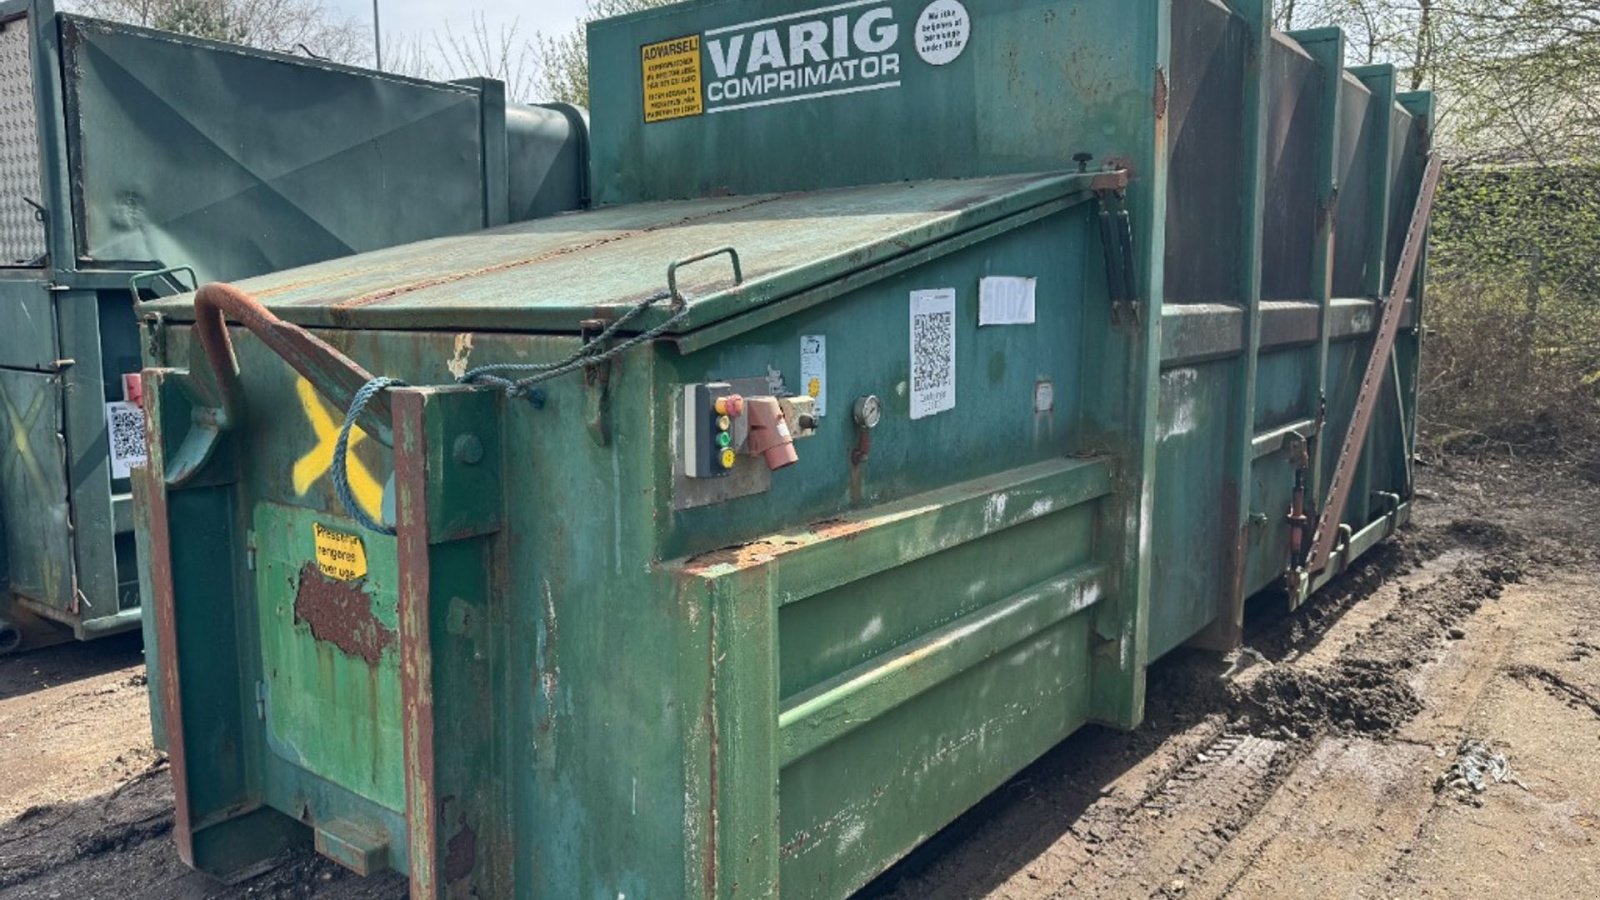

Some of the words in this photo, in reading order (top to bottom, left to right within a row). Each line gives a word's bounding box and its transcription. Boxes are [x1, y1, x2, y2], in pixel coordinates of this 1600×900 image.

[643, 38, 698, 62] ADVARSEL!
[706, 7, 899, 78] VARIG
[707, 53, 900, 102] COMPRIMATOR
